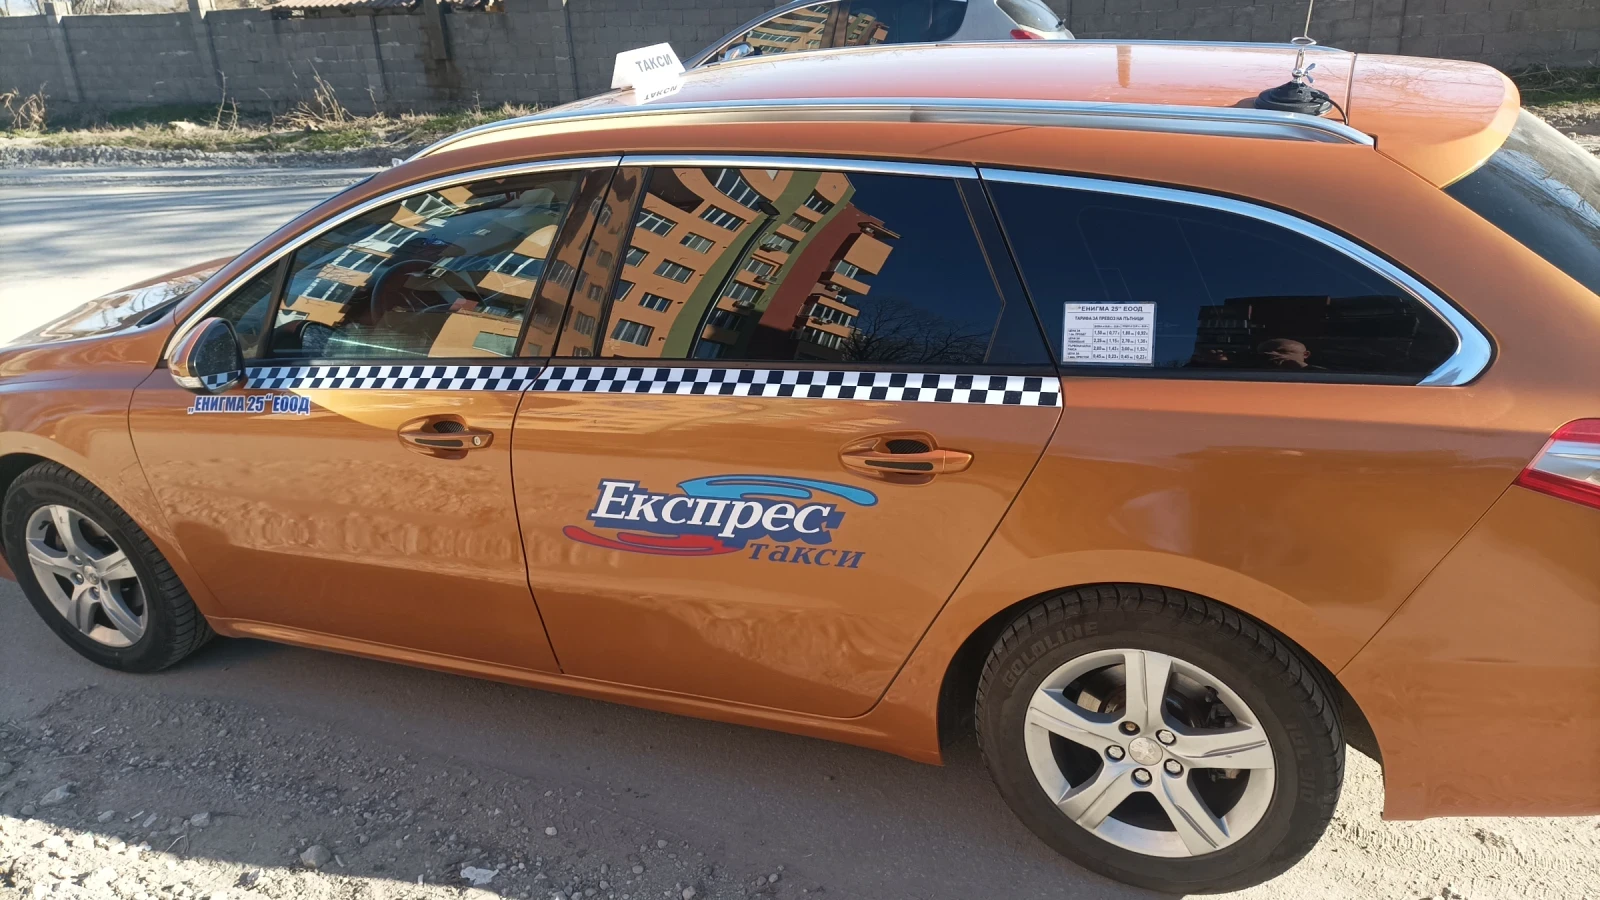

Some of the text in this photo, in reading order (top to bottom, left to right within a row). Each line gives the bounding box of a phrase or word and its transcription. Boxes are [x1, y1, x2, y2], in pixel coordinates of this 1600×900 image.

[635, 53, 673, 73] ТАКСИ
[273, 396, 311, 415] ЕООД
[591, 480, 832, 539] Експрес
[748, 543, 866, 569] такси
[1002, 621, 1099, 689] GOLDLINE
